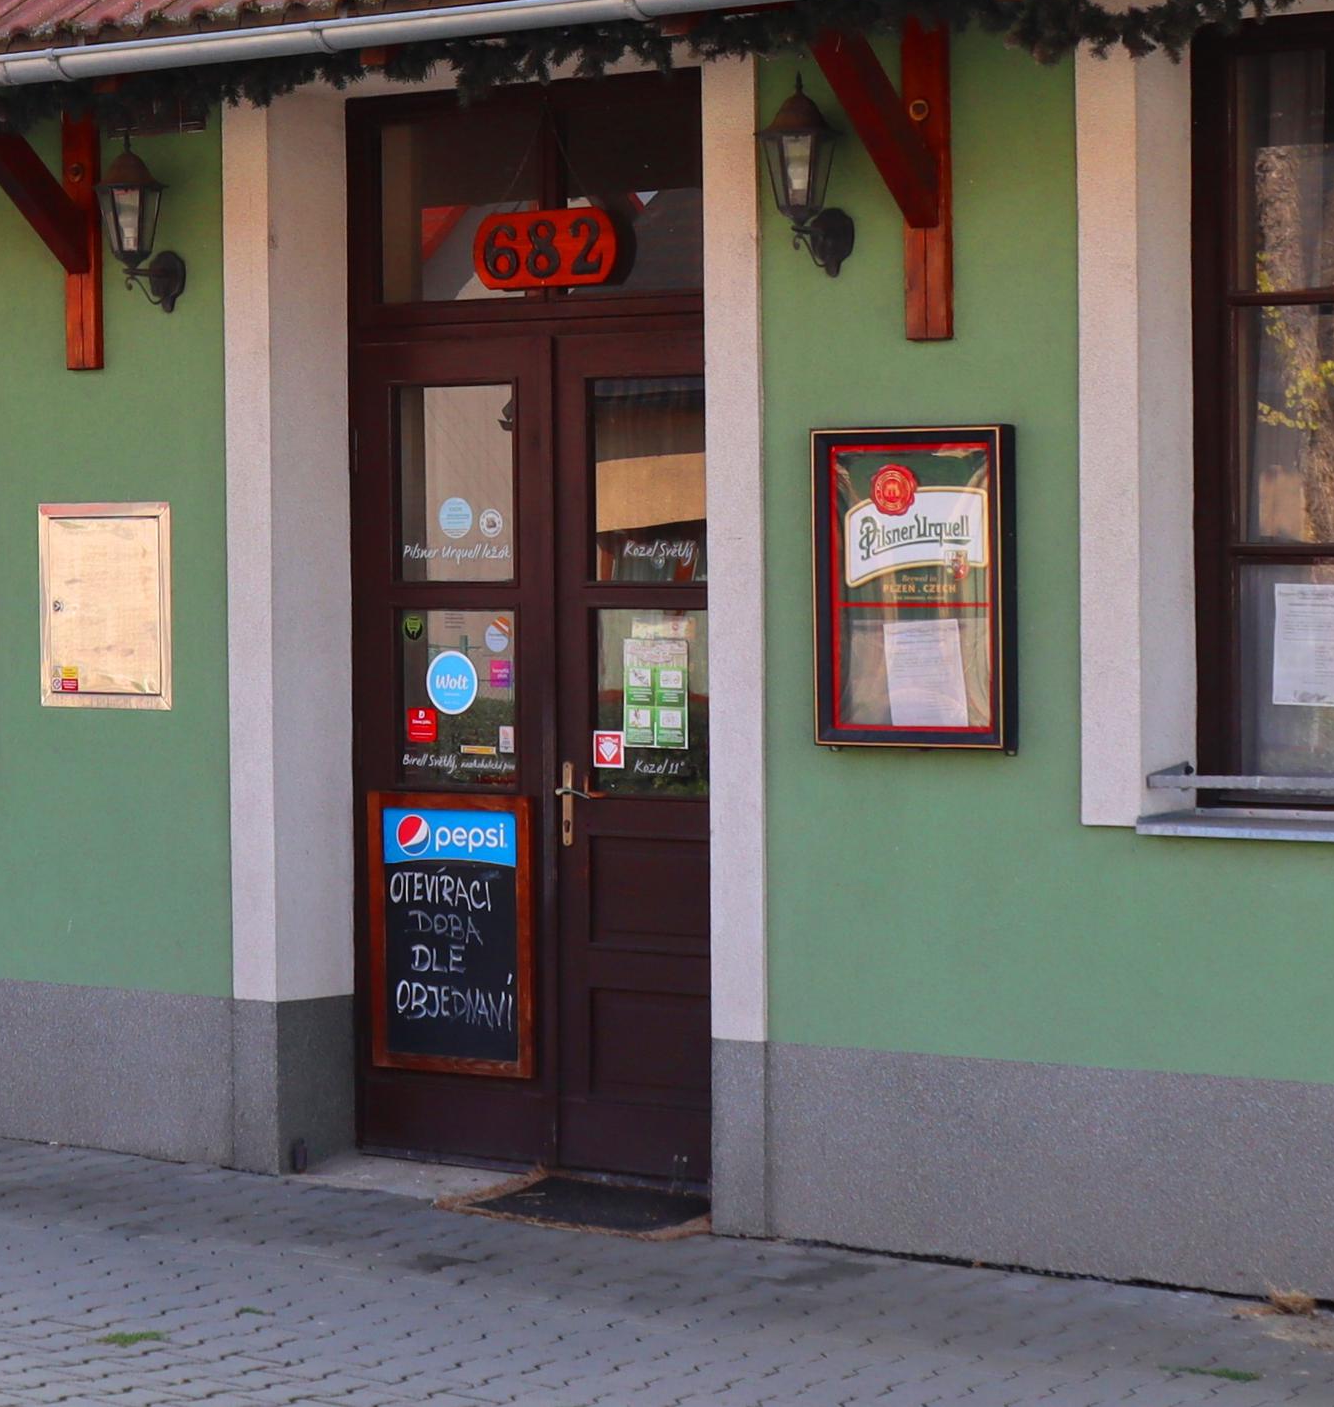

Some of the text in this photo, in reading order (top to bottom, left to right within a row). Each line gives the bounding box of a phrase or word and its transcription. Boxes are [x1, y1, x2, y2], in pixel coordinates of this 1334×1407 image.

[483, 217, 604, 280] 682
[623, 539, 658, 557] Kozel
[859, 514, 970, 561] Pilsner Urquell
[403, 543, 439, 558] Pilsner
[442, 544, 481, 565] Urquell
[435, 674, 469, 690] Wolt
[403, 753, 428, 766] Birell
[634, 758, 668, 774] Kozel
[435, 823, 505, 853] pepsi
[408, 910, 483, 945] DOBA
[411, 944, 466, 973] DLE
